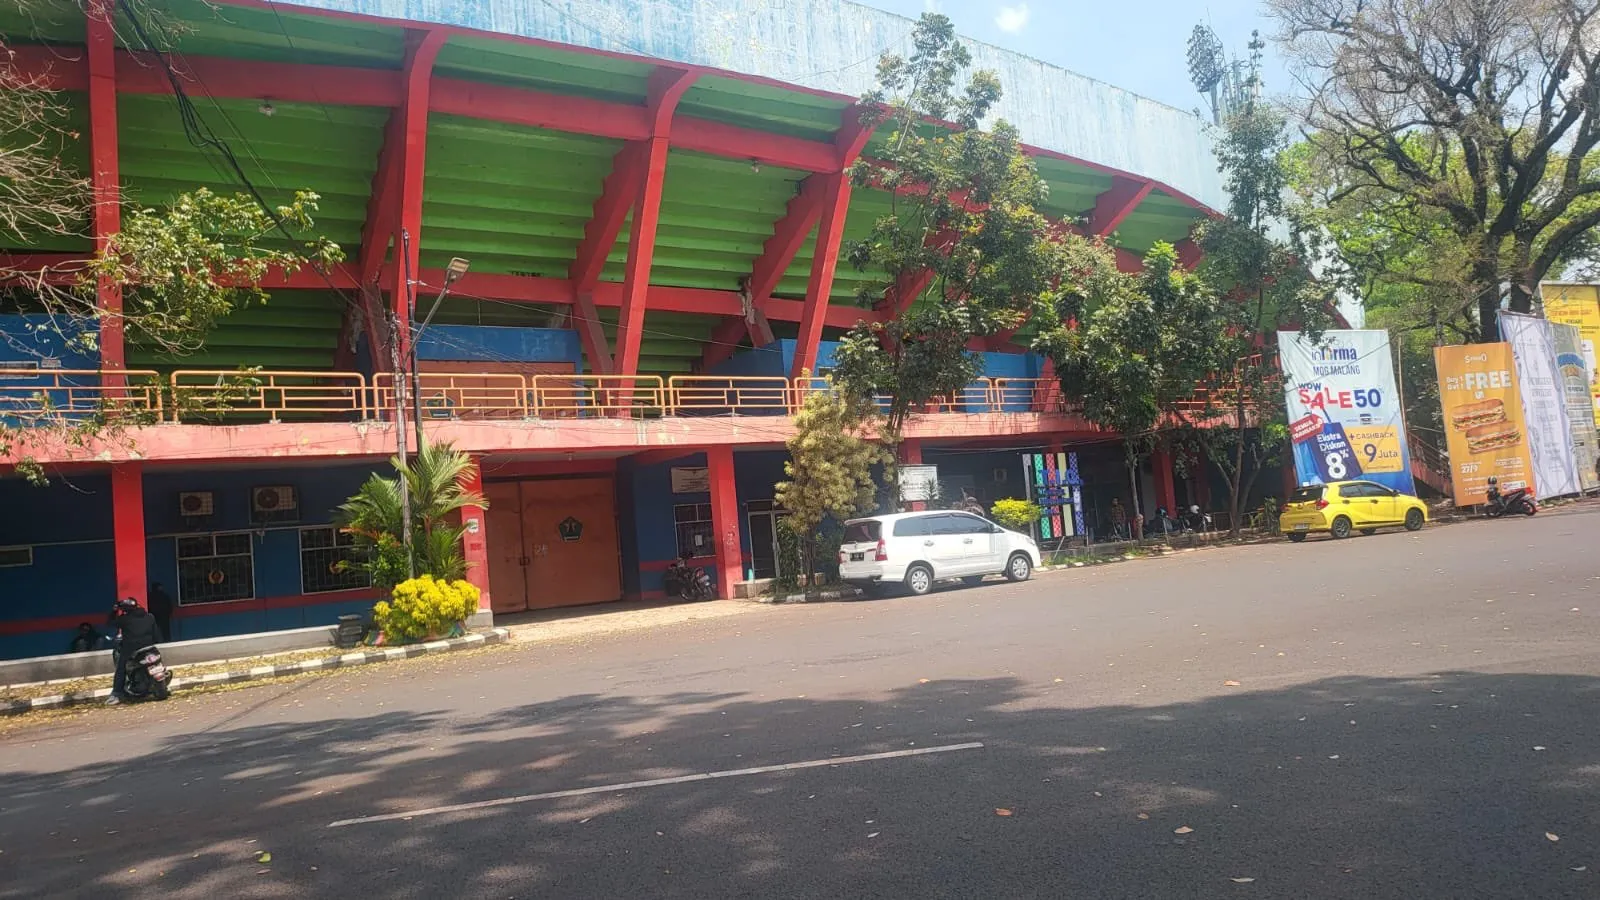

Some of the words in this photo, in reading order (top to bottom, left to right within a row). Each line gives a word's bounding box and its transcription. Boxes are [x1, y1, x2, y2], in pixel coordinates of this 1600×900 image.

[1465, 370, 1512, 390] FREE
[1298, 387, 1353, 409] SALE
[1316, 432, 1341, 442] Ekstra
[1319, 441, 1346, 451] Diskon
[1364, 443, 1377, 462] 9
